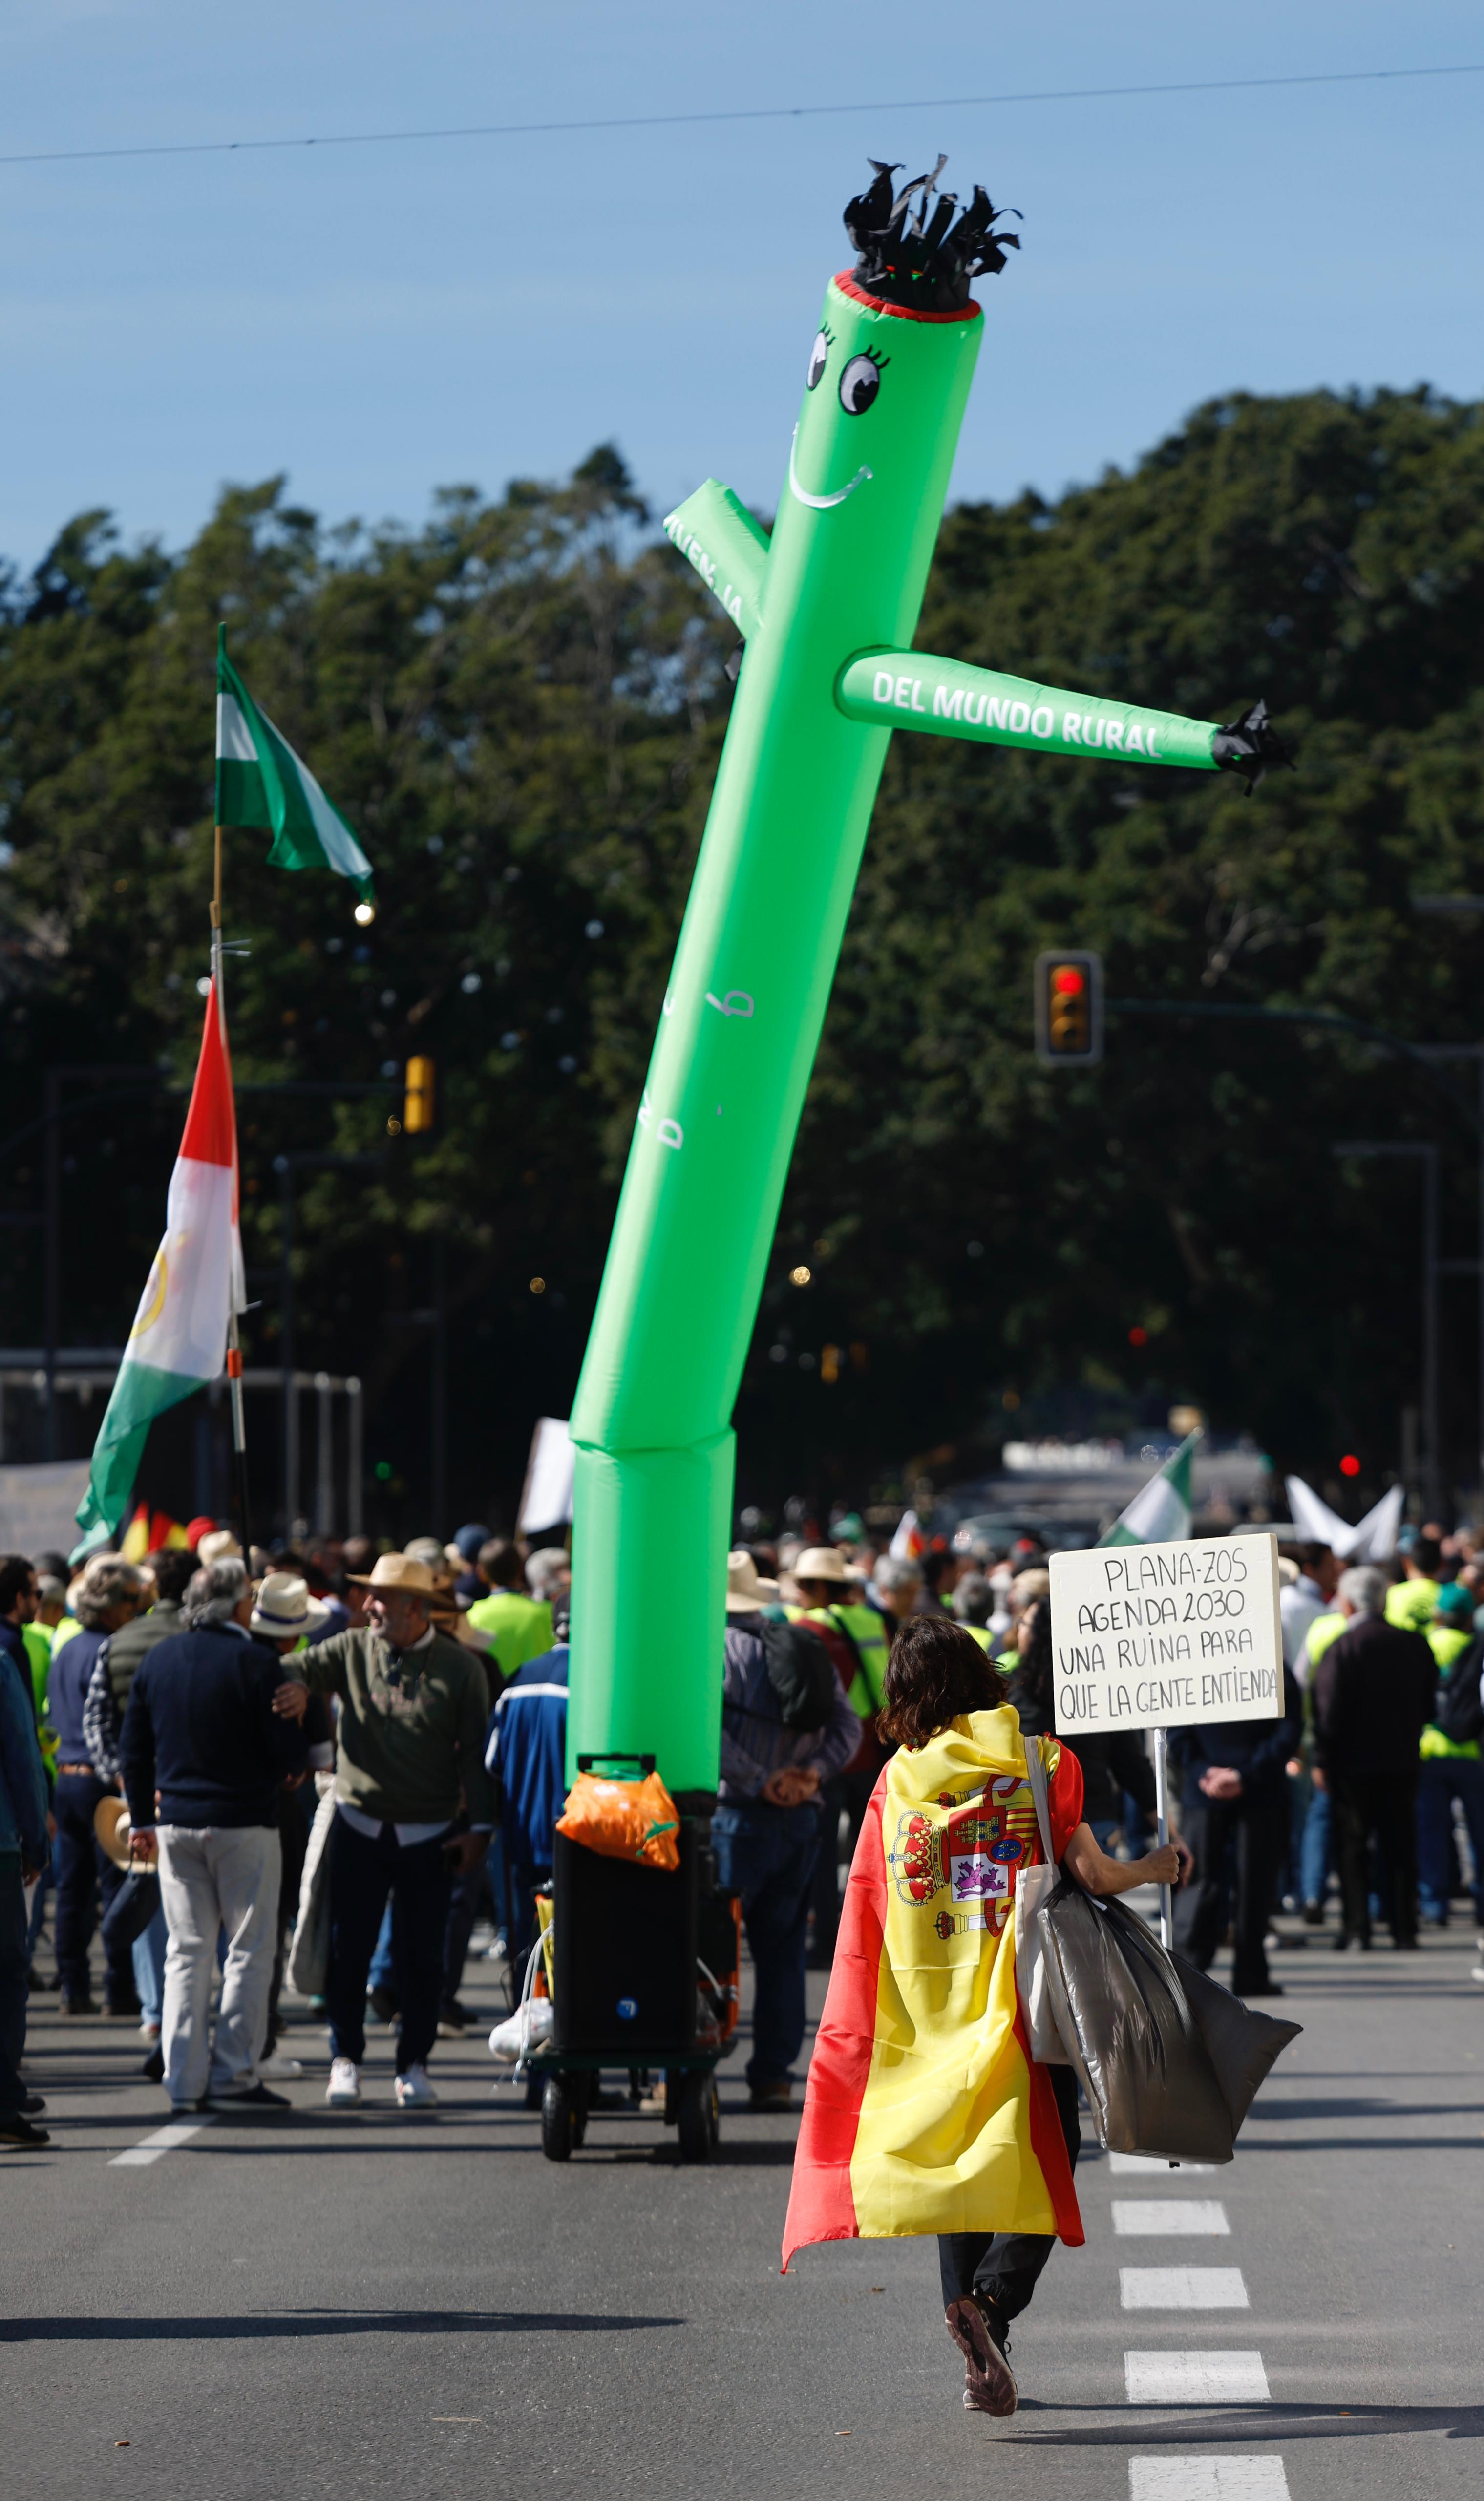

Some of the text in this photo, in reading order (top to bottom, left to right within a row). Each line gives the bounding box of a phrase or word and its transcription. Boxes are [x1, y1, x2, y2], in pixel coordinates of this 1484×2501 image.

[872, 671, 1163, 759] DEL MUNDO RURAL
[1078, 1590, 1245, 1635] AGENDA 2030
[1059, 1643, 1106, 1675] UNA
[1200, 1628, 1253, 1659] PARA
[1060, 1683, 1099, 1720] QUE
[1107, 1683, 1132, 1717] LA
[1136, 1677, 1197, 1712] GENTE
